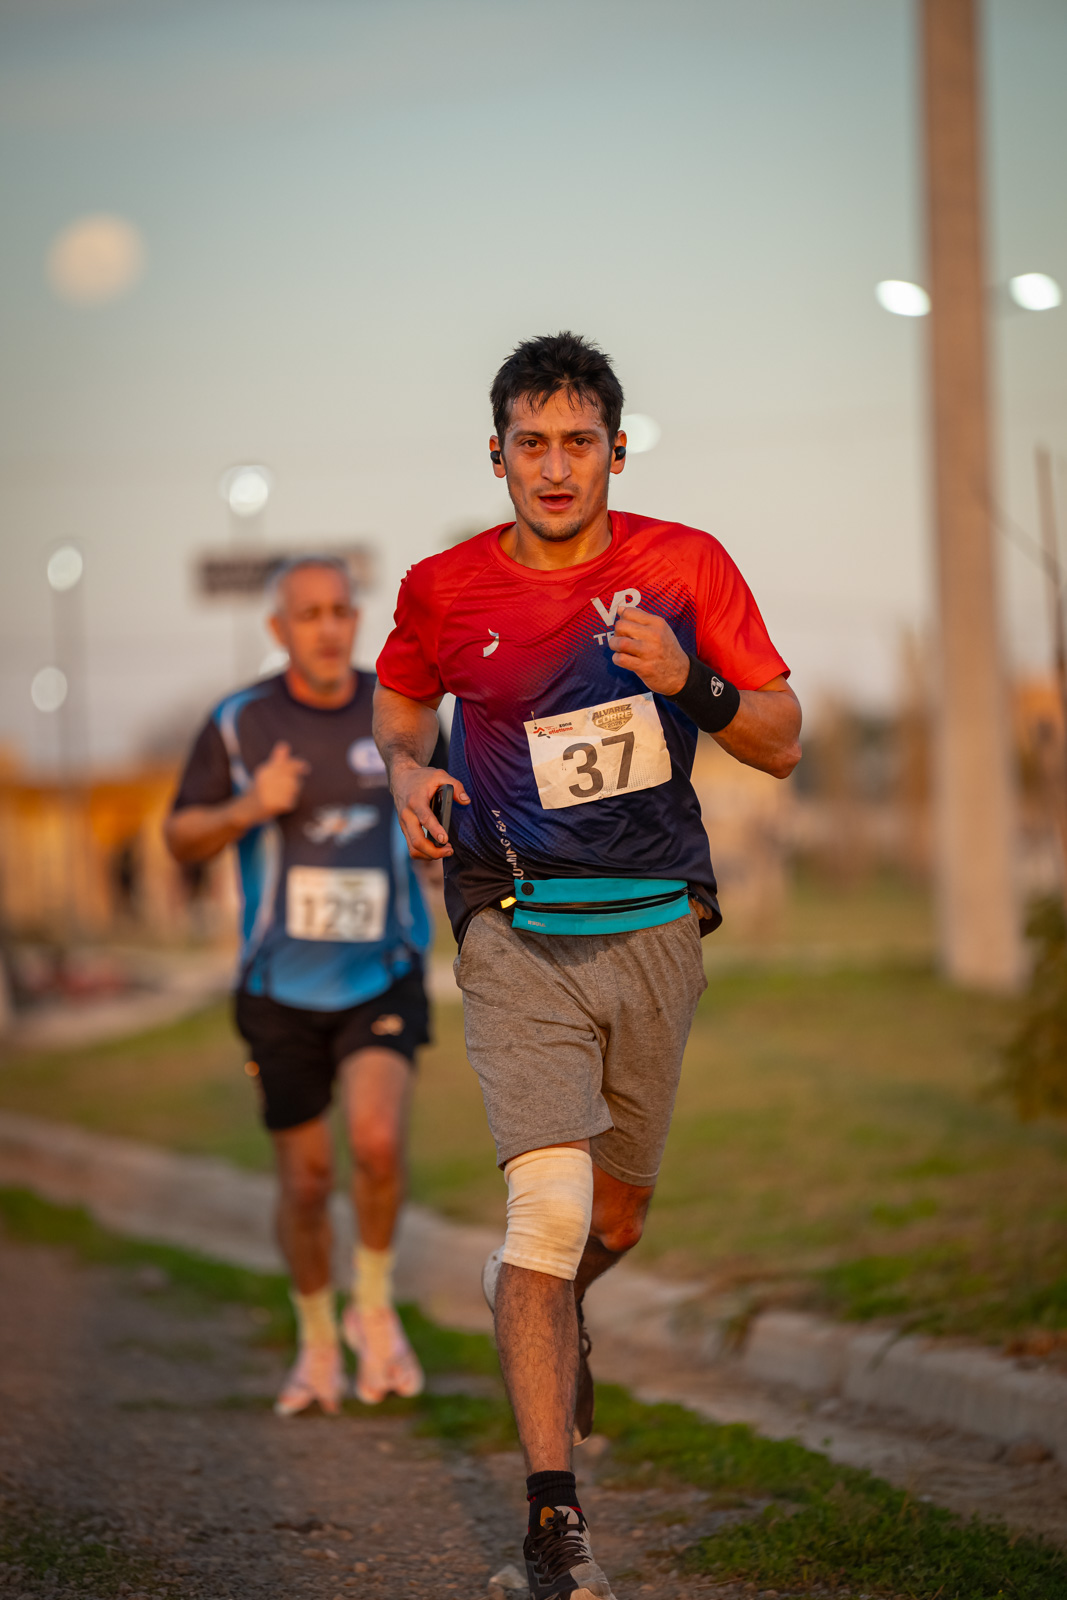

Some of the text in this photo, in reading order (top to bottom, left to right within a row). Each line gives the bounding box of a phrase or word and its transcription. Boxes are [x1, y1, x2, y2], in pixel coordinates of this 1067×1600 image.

[592, 703, 632, 720] ALVAREZ
[595, 710, 632, 725] CORRE
[562, 731, 635, 798] 37
